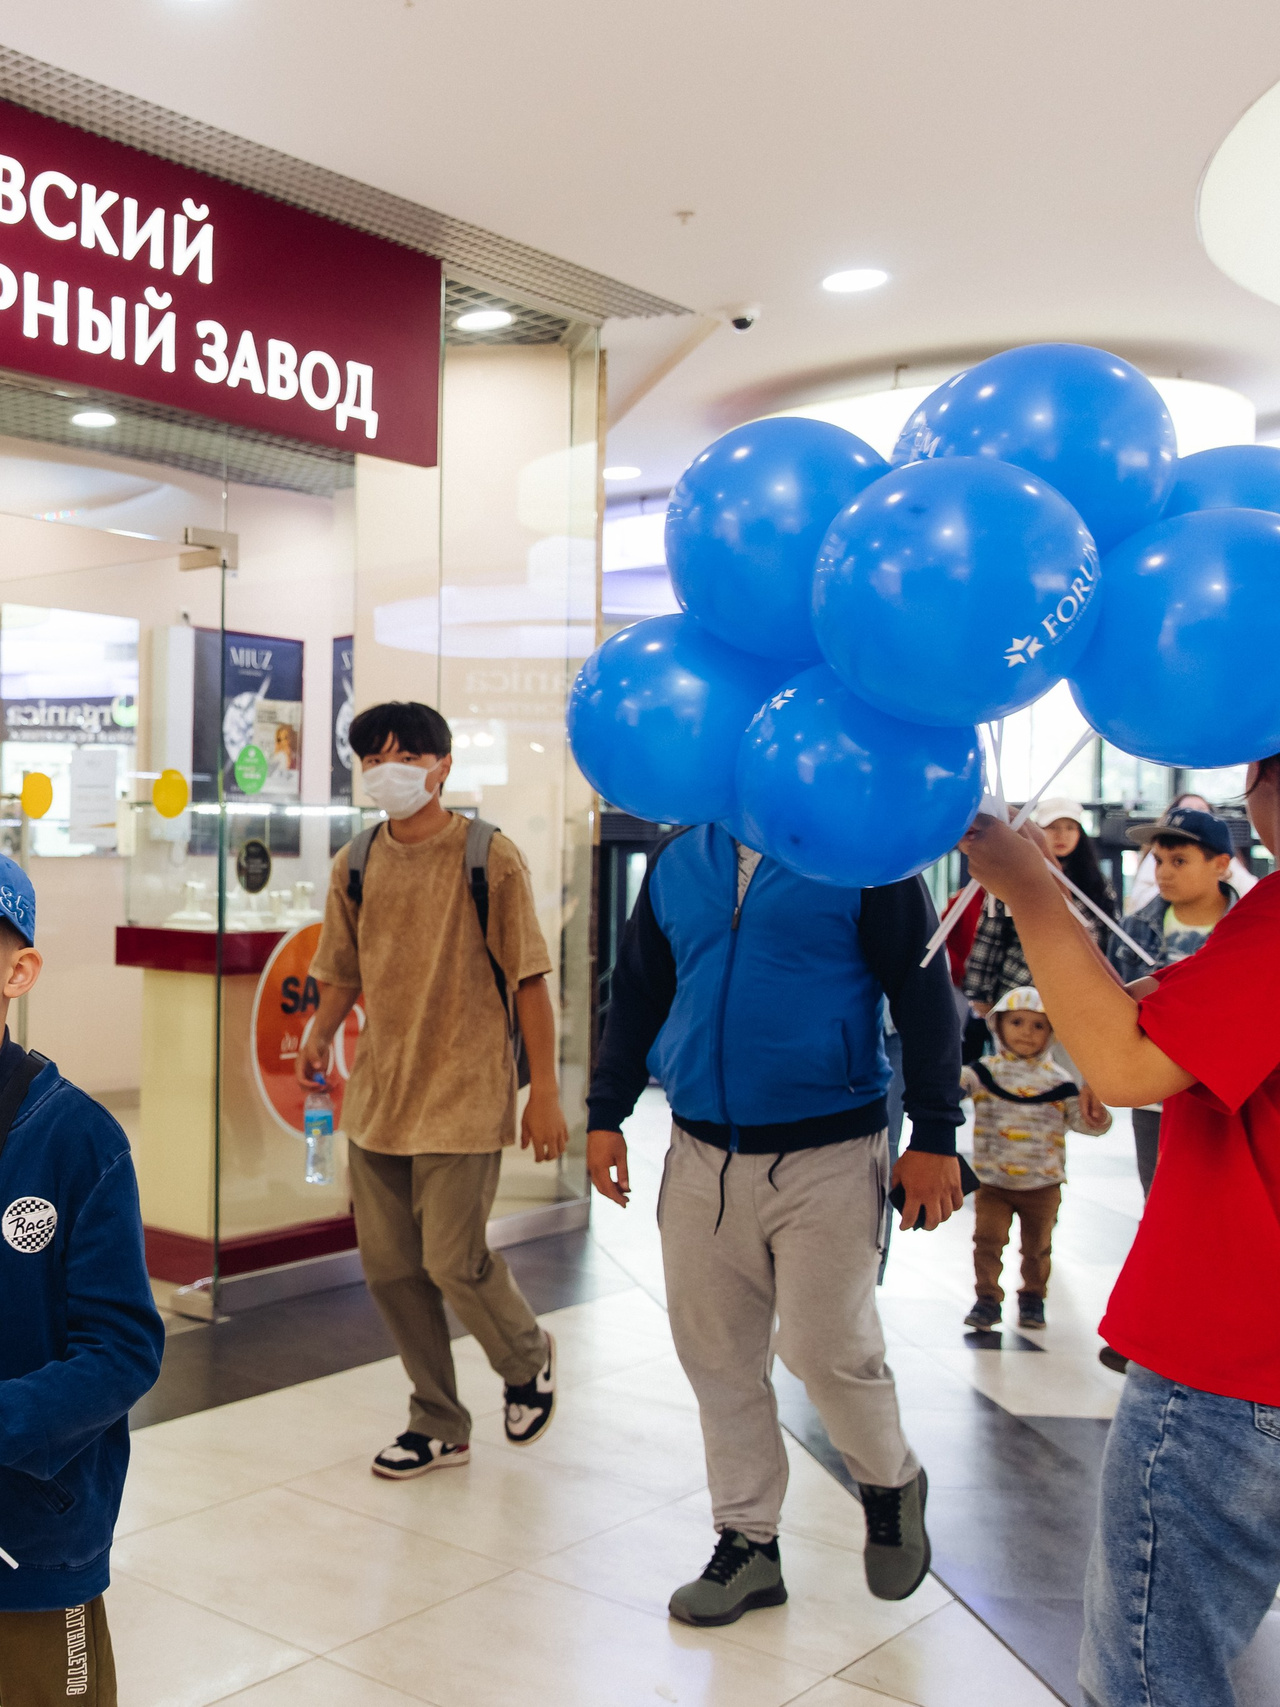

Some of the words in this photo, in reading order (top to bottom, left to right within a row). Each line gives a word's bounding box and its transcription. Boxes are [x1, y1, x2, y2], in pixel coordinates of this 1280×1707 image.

[194, 319, 379, 439] ЗАВОД
[229, 646, 273, 671] MIUZ
[8, 1216, 54, 1236] RACE
[65, 1604, 88, 1696] ATHLETIC
